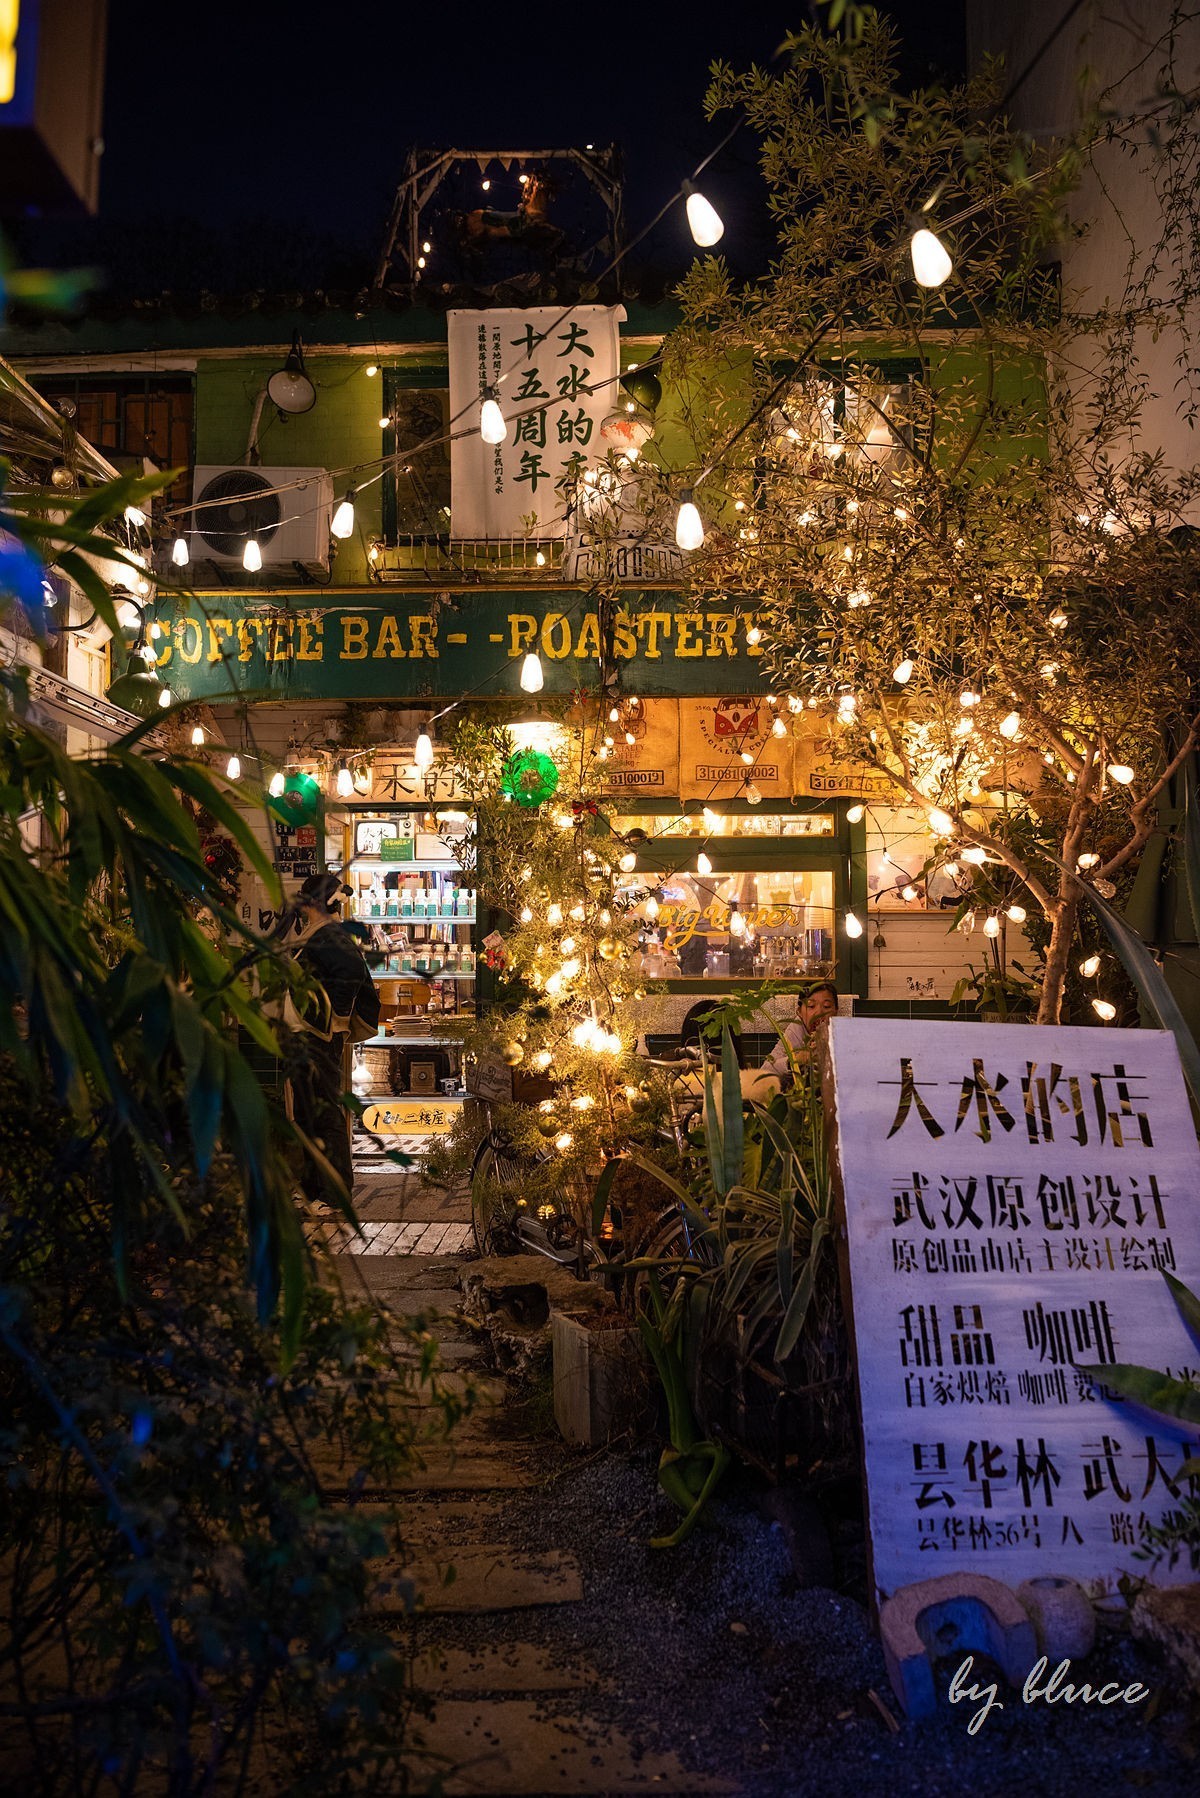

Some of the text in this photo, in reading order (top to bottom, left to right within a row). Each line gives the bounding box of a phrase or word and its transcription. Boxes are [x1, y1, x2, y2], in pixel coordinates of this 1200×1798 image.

[510, 323, 551, 493] 十五周年
[145, 617, 324, 667] COFFEE
[658, 904, 720, 951] Big
[877, 1057, 1155, 1148] 大水的店
[891, 1171, 1170, 1231] 武汉原创设计
[892, 1236, 1177, 1274] 原创品由店主设计绘制
[899, 1301, 1120, 1367] 甜品 咖啡
[910, 1437, 1062, 1510] 昙华林
